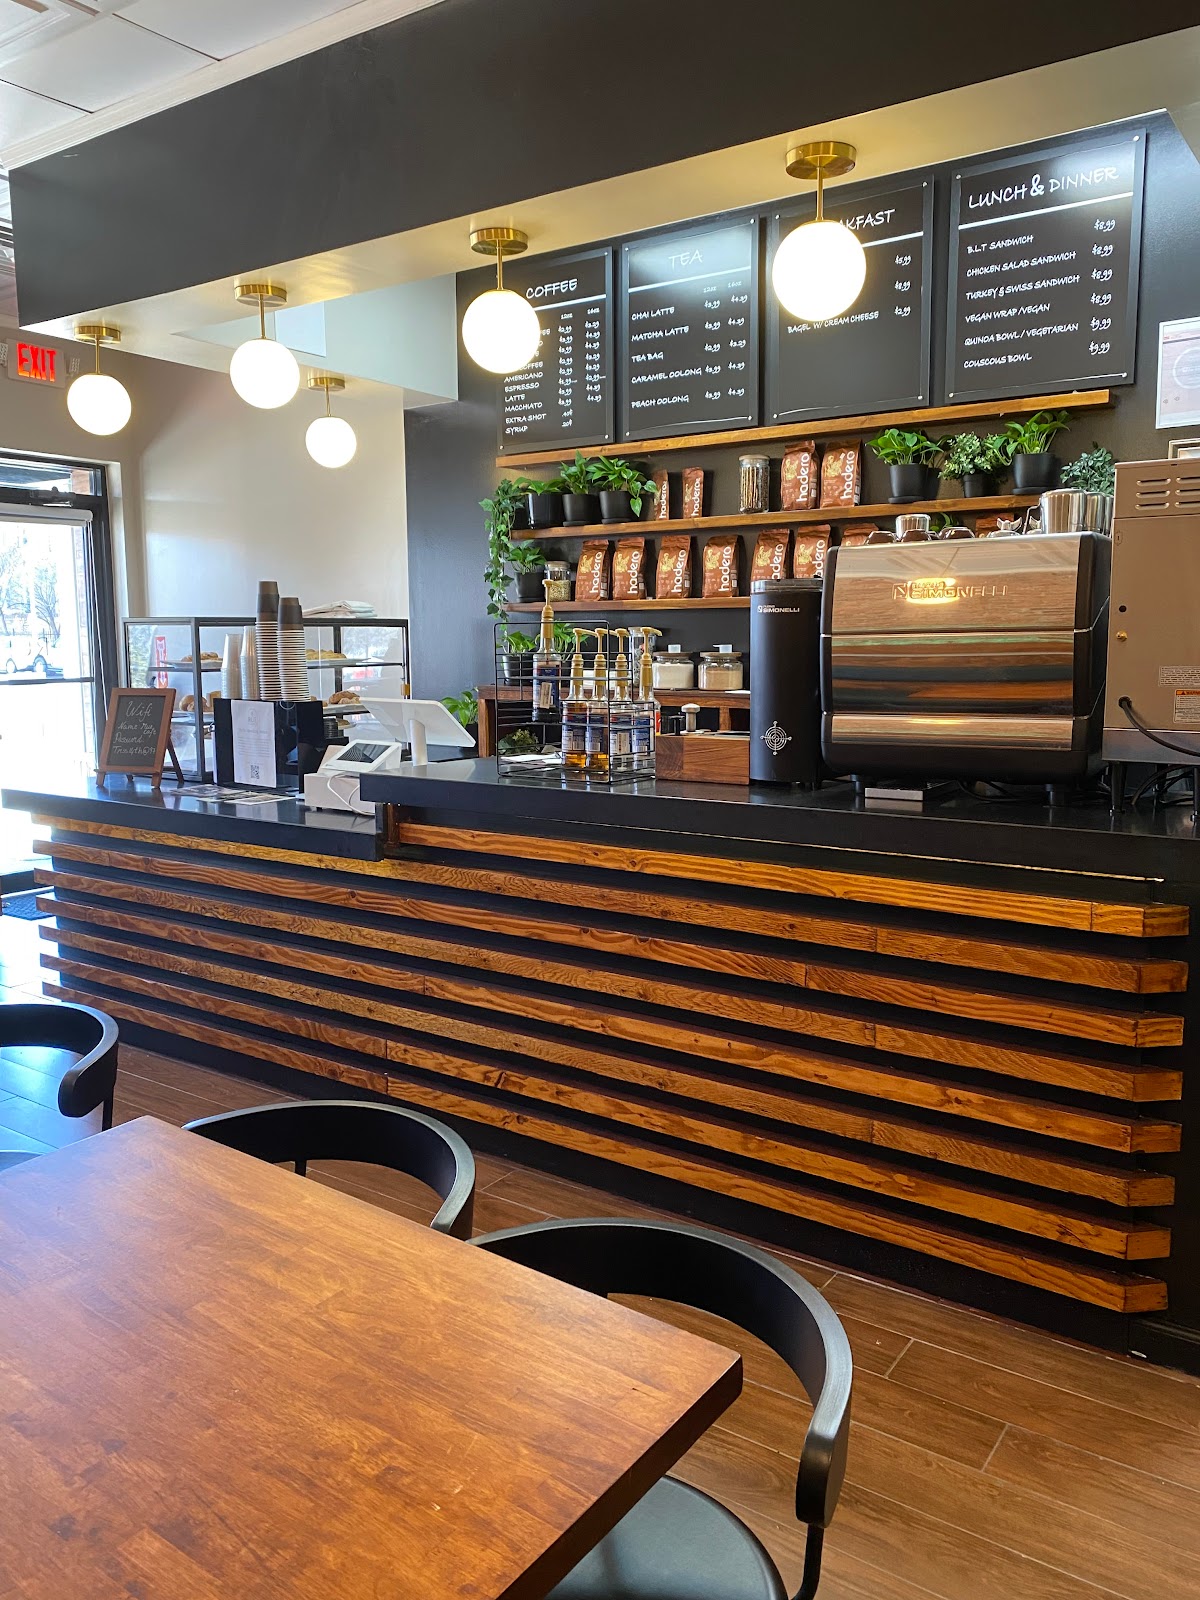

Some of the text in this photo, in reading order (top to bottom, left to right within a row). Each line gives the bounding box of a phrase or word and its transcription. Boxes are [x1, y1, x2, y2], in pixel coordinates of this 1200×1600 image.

[968, 167, 1119, 209] LUNCH & DINNER
[1094, 219, 1116, 232] $8.99
[989, 235, 1034, 251] SANDWICH
[668, 250, 704, 270] TEA
[966, 244, 1114, 277] CHICKEN SALAD SANDWICH $8.99
[526, 279, 578, 299] COFFEE
[966, 286, 998, 300] TURKEY
[1005, 282, 1033, 294] SWISS
[1034, 274, 1080, 290] SANDWICH
[1091, 268, 1113, 281] $8.99
[631, 311, 650, 321] CHAI
[650, 306, 675, 317] LATTE
[965, 312, 992, 323] VEGAN
[993, 308, 1019, 319] WRAP
[1090, 292, 1112, 306] $8.99
[787, 323, 811, 333] BAGEL
[824, 317, 850, 327] CREAM
[850, 311, 879, 323] CHEESE
[996, 330, 1020, 342] BOWL
[1026, 323, 1079, 338] VEGETARIAN
[1090, 317, 1112, 331] $9.99
[631, 330, 664, 342] MATCHA
[664, 325, 690, 337] LATTE
[17, 342, 57, 382] EXIT
[631, 354, 646, 363] TEA
[646, 351, 664, 361] BAG
[963, 341, 1110, 368] COUSCOUS BOWL $9.99
[521, 361, 544, 371] OFFEE
[631, 372, 668, 384] CARAMEL
[669, 367, 702, 379] OOLONG
[504, 371, 544, 383] AMERICANO
[504, 382, 540, 393] ESPRESSO
[504, 393, 526, 403] LATTE
[504, 402, 543, 413] MACCHIATO
[631, 398, 656, 409] PEACH
[656, 395, 690, 406] OOLONG
[505, 415, 527, 425] EXTRA
[527, 413, 547, 422] SHOT
[505, 425, 528, 436] SYRUP
[796, 453, 810, 502] hadero
[840, 451, 855, 499] hadero
[659, 483, 668, 519] hadero
[691, 480, 700, 516] hadero
[589, 551, 603, 594] hadero
[627, 551, 640, 594] hadero
[671, 549, 687, 593] hadero
[718, 546, 732, 592] hadero
[126, 700, 153, 722] Wifi
[118, 721, 138, 731] Name
